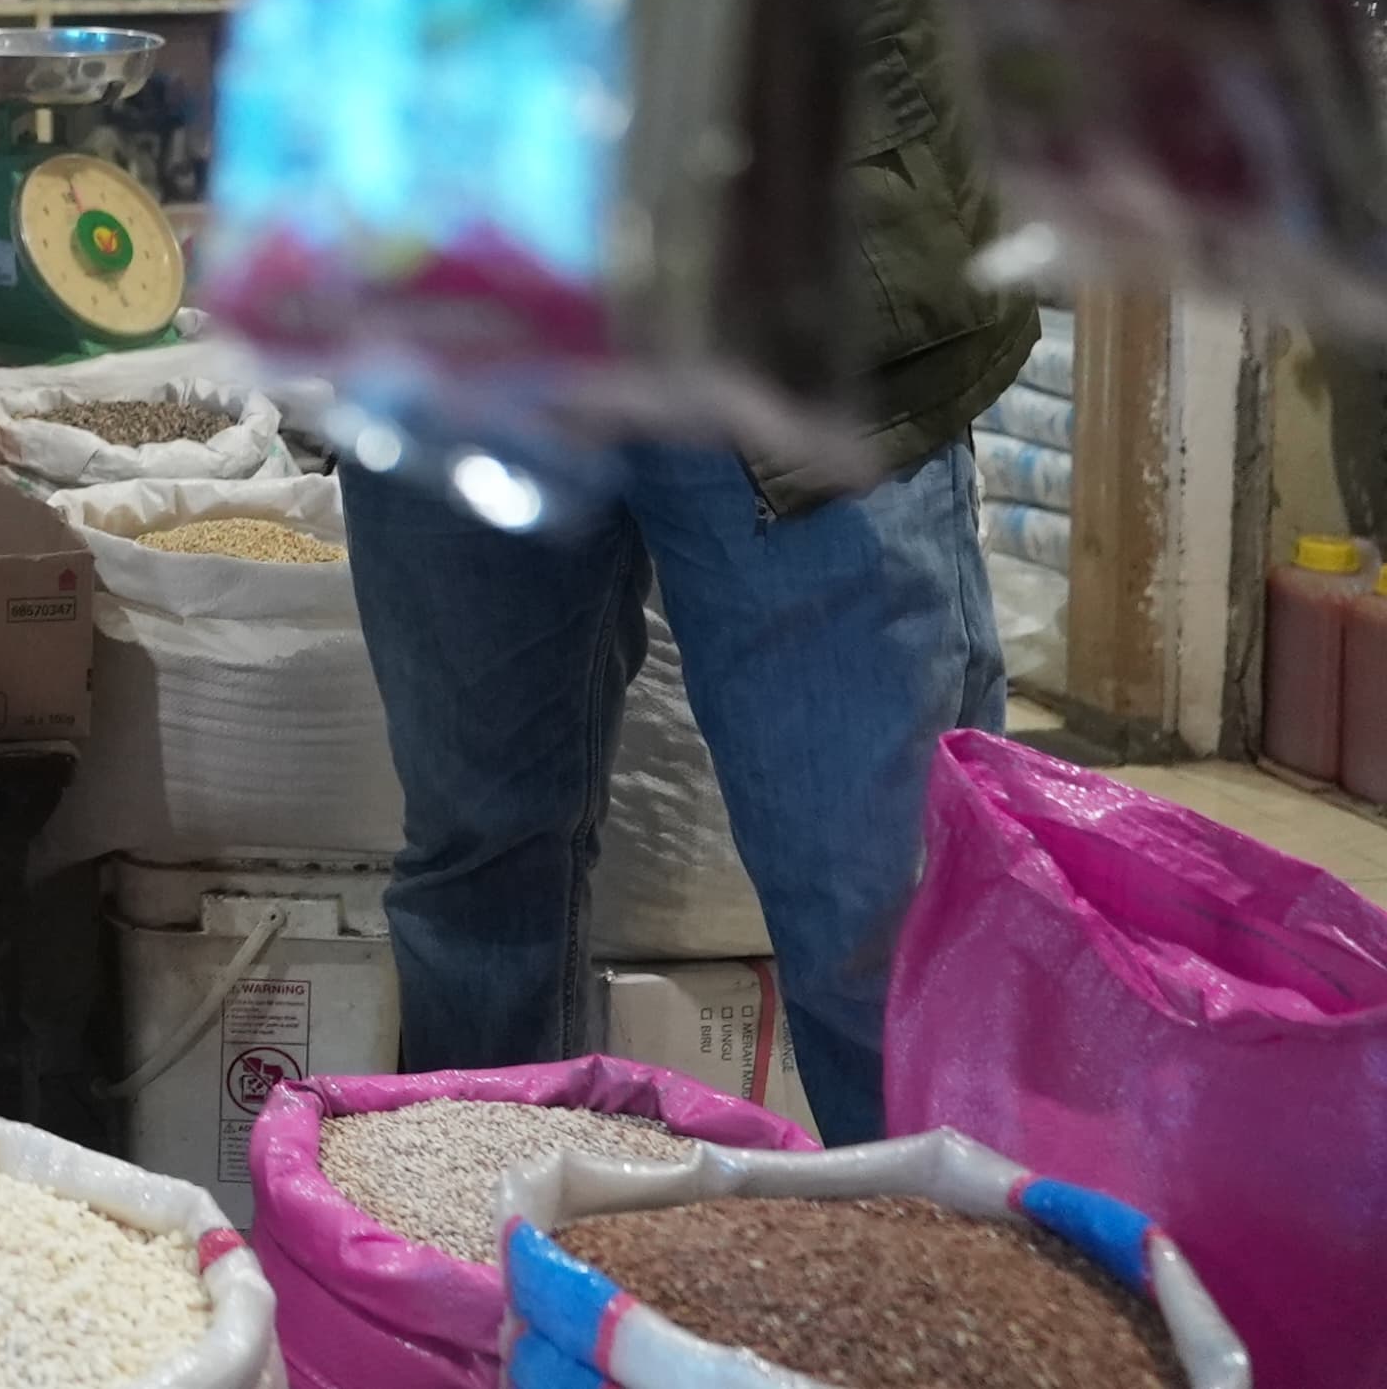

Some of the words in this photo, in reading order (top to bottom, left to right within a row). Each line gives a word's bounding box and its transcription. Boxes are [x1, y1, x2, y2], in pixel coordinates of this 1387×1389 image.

[700, 1025, 712, 1053] BIRU
[721, 1024, 732, 1061] UNGU
[741, 1022, 753, 1067] MERAH
